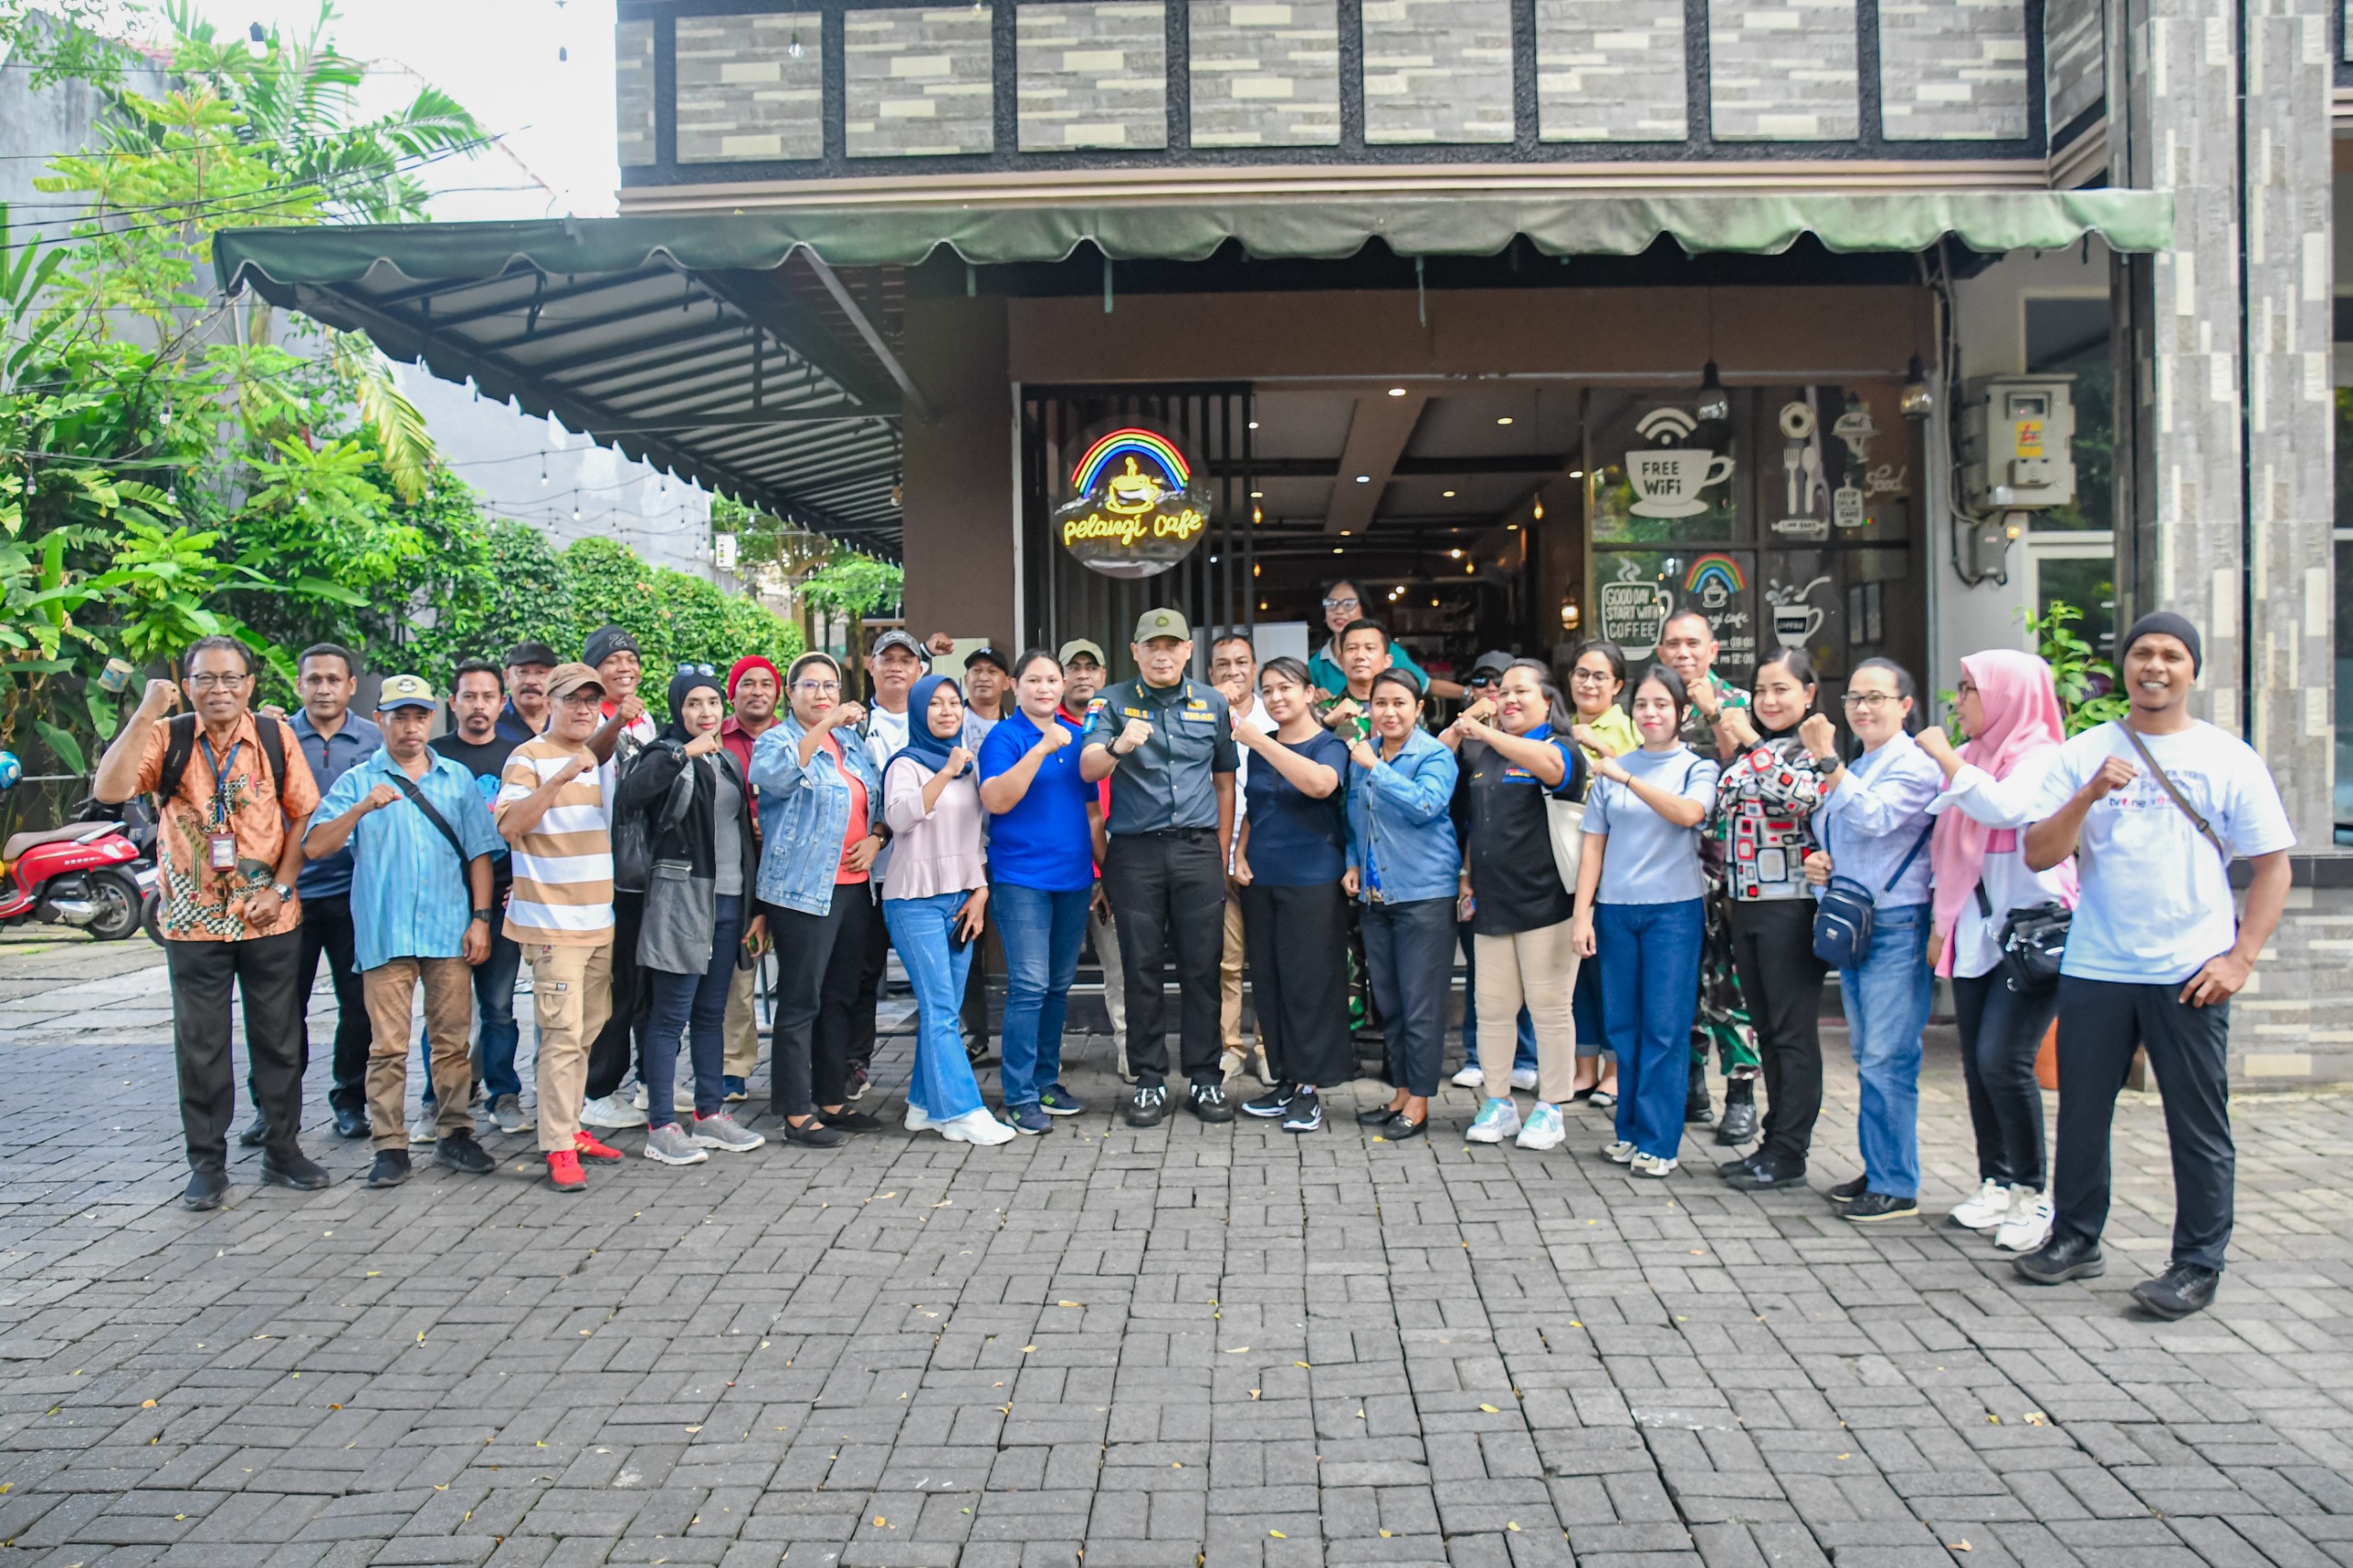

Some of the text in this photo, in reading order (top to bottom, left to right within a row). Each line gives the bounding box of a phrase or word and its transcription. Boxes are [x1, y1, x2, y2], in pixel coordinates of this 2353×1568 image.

[1642, 461, 1679, 476] FREE
[1643, 479, 1681, 495] WiFi
[1605, 588, 1651, 606] GOOD DAY
[1606, 605, 1660, 621] START WITH
[1608, 622, 1656, 639] COFFEE
